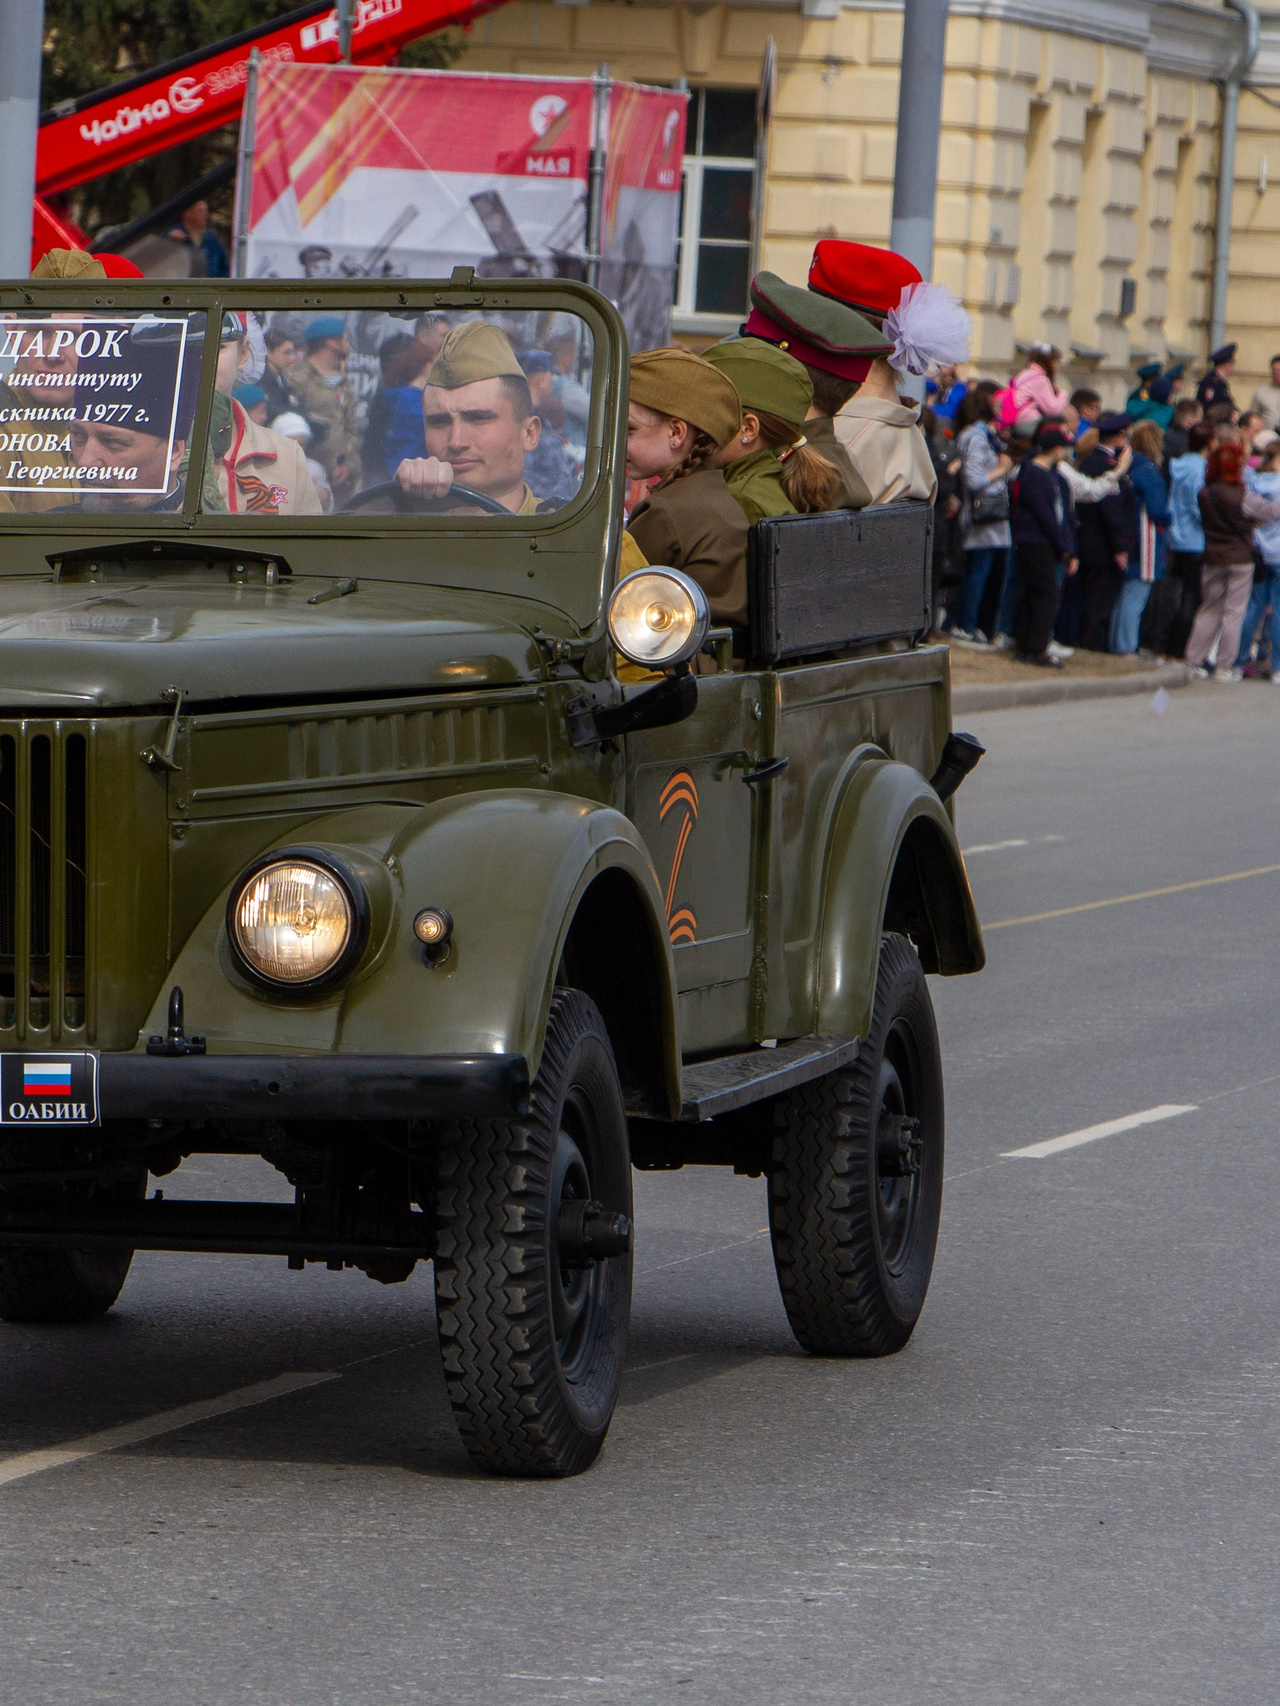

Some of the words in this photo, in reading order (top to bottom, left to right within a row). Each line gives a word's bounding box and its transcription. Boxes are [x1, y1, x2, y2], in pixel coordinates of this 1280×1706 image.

[526, 156, 571, 174] МАЯ
[8, 370, 142, 392] институту
[81, 403, 132, 422] 1977
[135, 408, 150, 422] г.
[6, 461, 139, 485] Георгиевича
[8, 1102, 88, 1120] ОАБИИ
